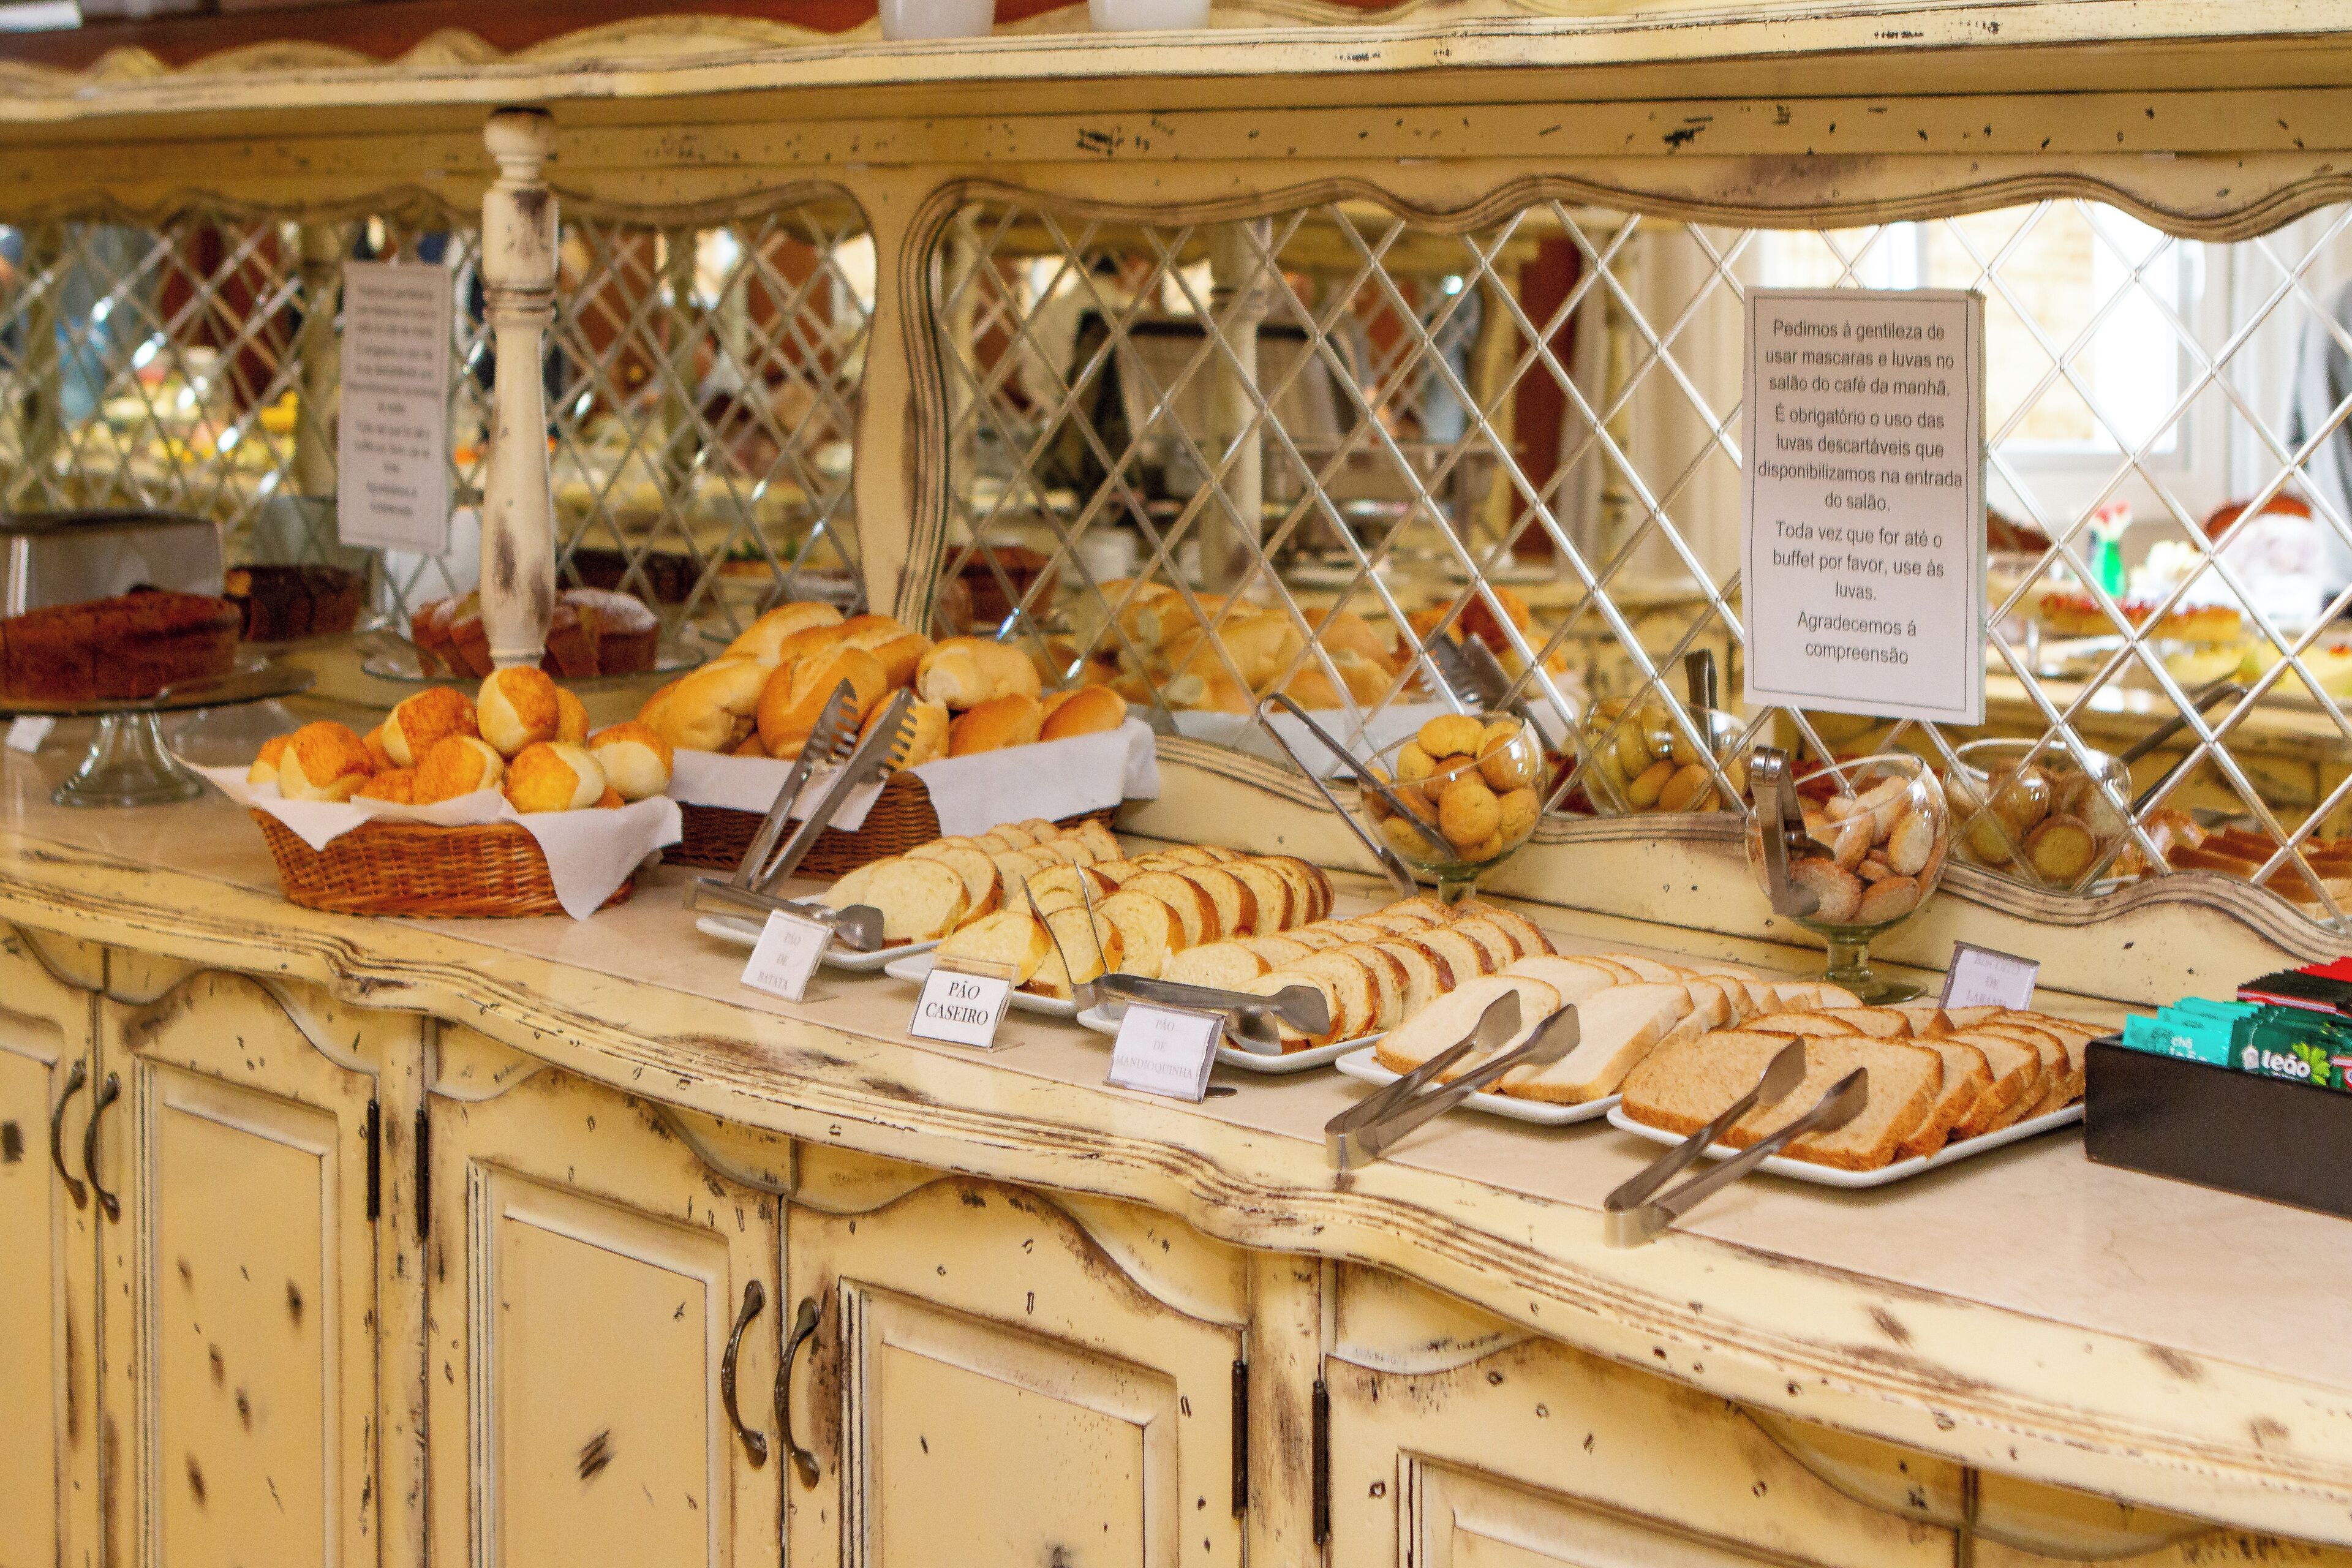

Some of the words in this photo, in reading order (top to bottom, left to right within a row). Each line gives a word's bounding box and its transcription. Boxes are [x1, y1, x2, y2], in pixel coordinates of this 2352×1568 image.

[1774, 318, 1838, 337] Pedimos
[1856, 322, 1922, 342] gentileza
[1928, 322, 1945, 341] de
[1766, 350, 1798, 364] usar
[1879, 355, 1887, 367] e
[1893, 350, 1931, 368] luvas
[1937, 355, 1954, 369] no
[1770, 374, 1807, 391] salão
[1812, 375, 1830, 392] do
[1834, 376, 1866, 393] café
[1871, 377, 1888, 394] da
[1894, 379, 1950, 396] manhã.
[1776, 402, 1785, 423] É
[1790, 407, 1865, 428] obrigatório
[1871, 413, 1879, 426] o
[1885, 414, 1912, 428] uso
[1917, 412, 1944, 429] das
[1777, 434, 1812, 452] luvas
[1818, 435, 1910, 457] descartáveis
[1915, 443, 1944, 461] que
[1758, 461, 1875, 483] disponibilizamos
[1881, 471, 1899, 484] na
[1905, 470, 1962, 488] entrada
[1825, 492, 1842, 509] do
[1847, 492, 1890, 511] salão.
[1776, 520, 1813, 540] Toda
[1818, 527, 1842, 541] vez
[1847, 529, 1874, 547] que
[1879, 527, 1900, 545] for
[1905, 529, 1928, 548] até
[1933, 535, 1942, 549] o
[1773, 548, 1814, 568] buffet
[1819, 556, 1842, 573] por
[1847, 553, 1888, 577] favor,
[1894, 560, 1921, 576] use
[1836, 581, 1877, 601] luvas.
[1798, 611, 1901, 636] Agradecemos
[1805, 643, 1909, 665] compreensão
[948, 980, 981, 1000] PÃO
[925, 1003, 989, 1025] CASEIRO
[1153, 1039, 1167, 1053] DE
[1115, 1054, 1193, 1079] MANDIOQUINHA
[2261, 1049, 2311, 1079] leão
